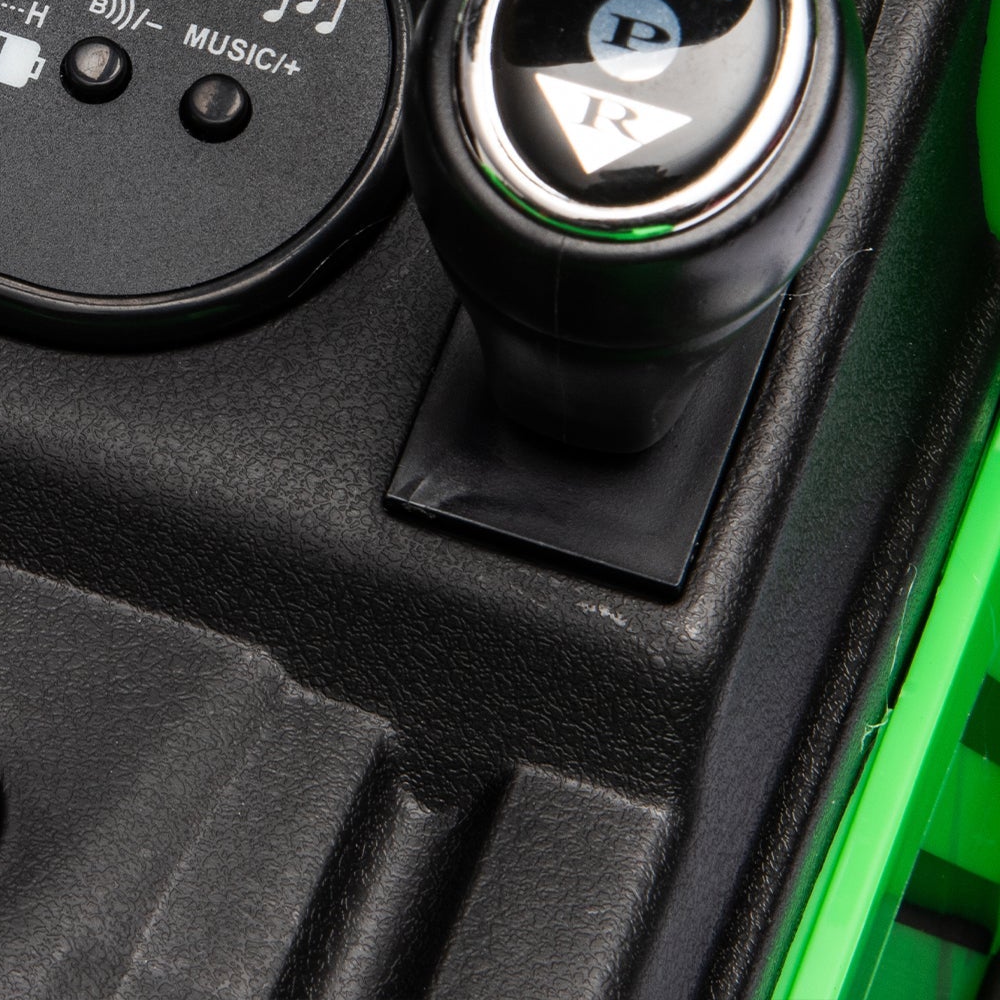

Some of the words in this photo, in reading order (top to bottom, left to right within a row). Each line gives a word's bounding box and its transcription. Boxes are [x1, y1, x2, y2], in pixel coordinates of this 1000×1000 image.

[183, 23, 302, 78] MUSIC/+
[601, 12, 672, 51] P
[576, 94, 642, 144] R
